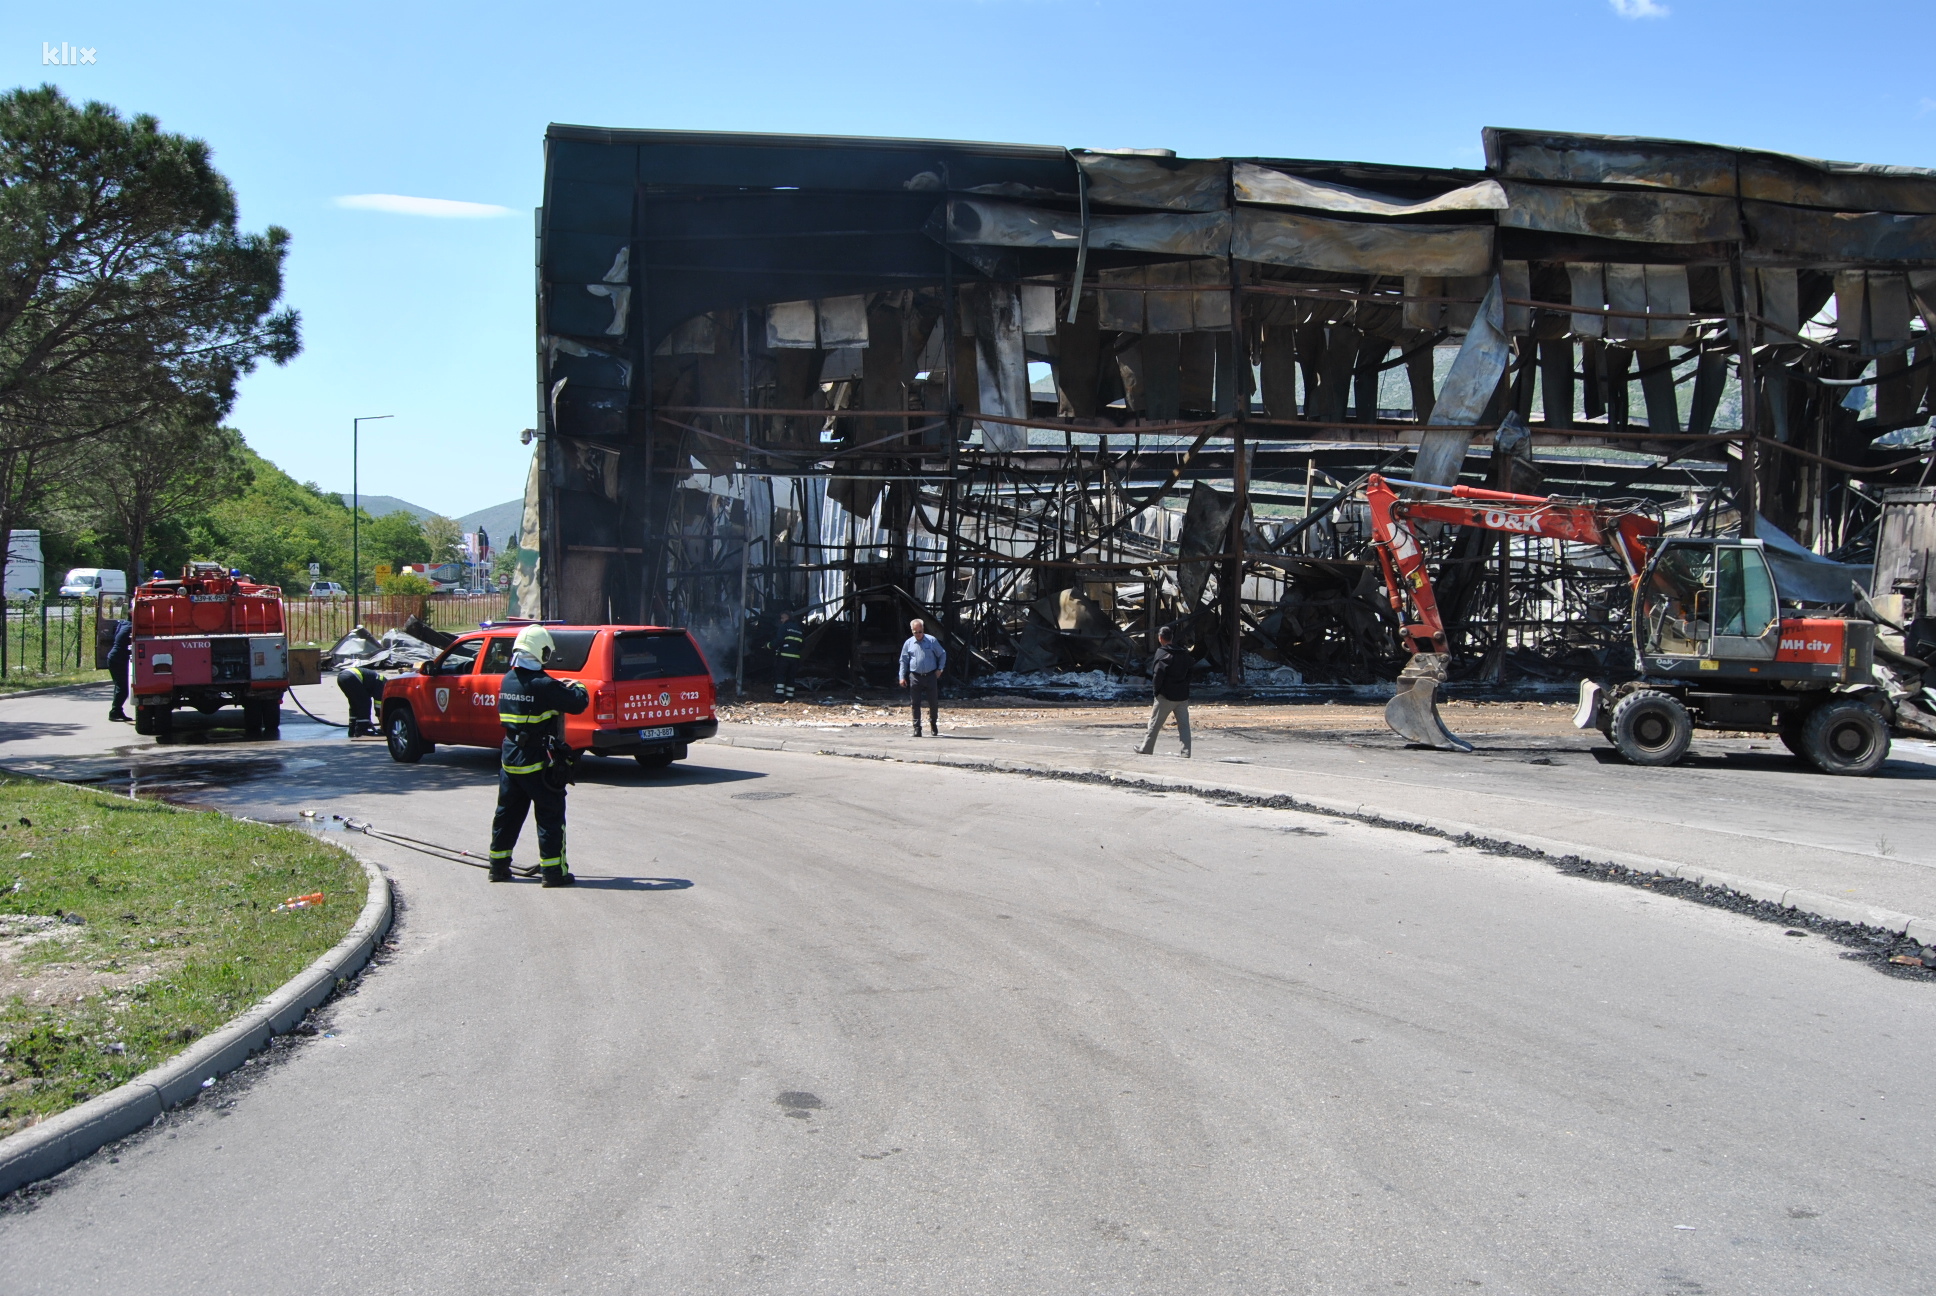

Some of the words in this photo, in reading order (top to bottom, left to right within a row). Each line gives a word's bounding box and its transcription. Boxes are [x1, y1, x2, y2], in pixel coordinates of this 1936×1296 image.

[1485, 510, 1543, 532] O&K
[181, 641, 211, 649] VATRO
[1780, 639, 1804, 650] MH
[1806, 639, 1832, 654] city
[480, 694, 496, 706] 123
[629, 693, 652, 701] GRAD
[687, 691, 699, 700] 123
[624, 700, 658, 709] MOSTAR
[624, 707, 700, 720] VATROGASCI
